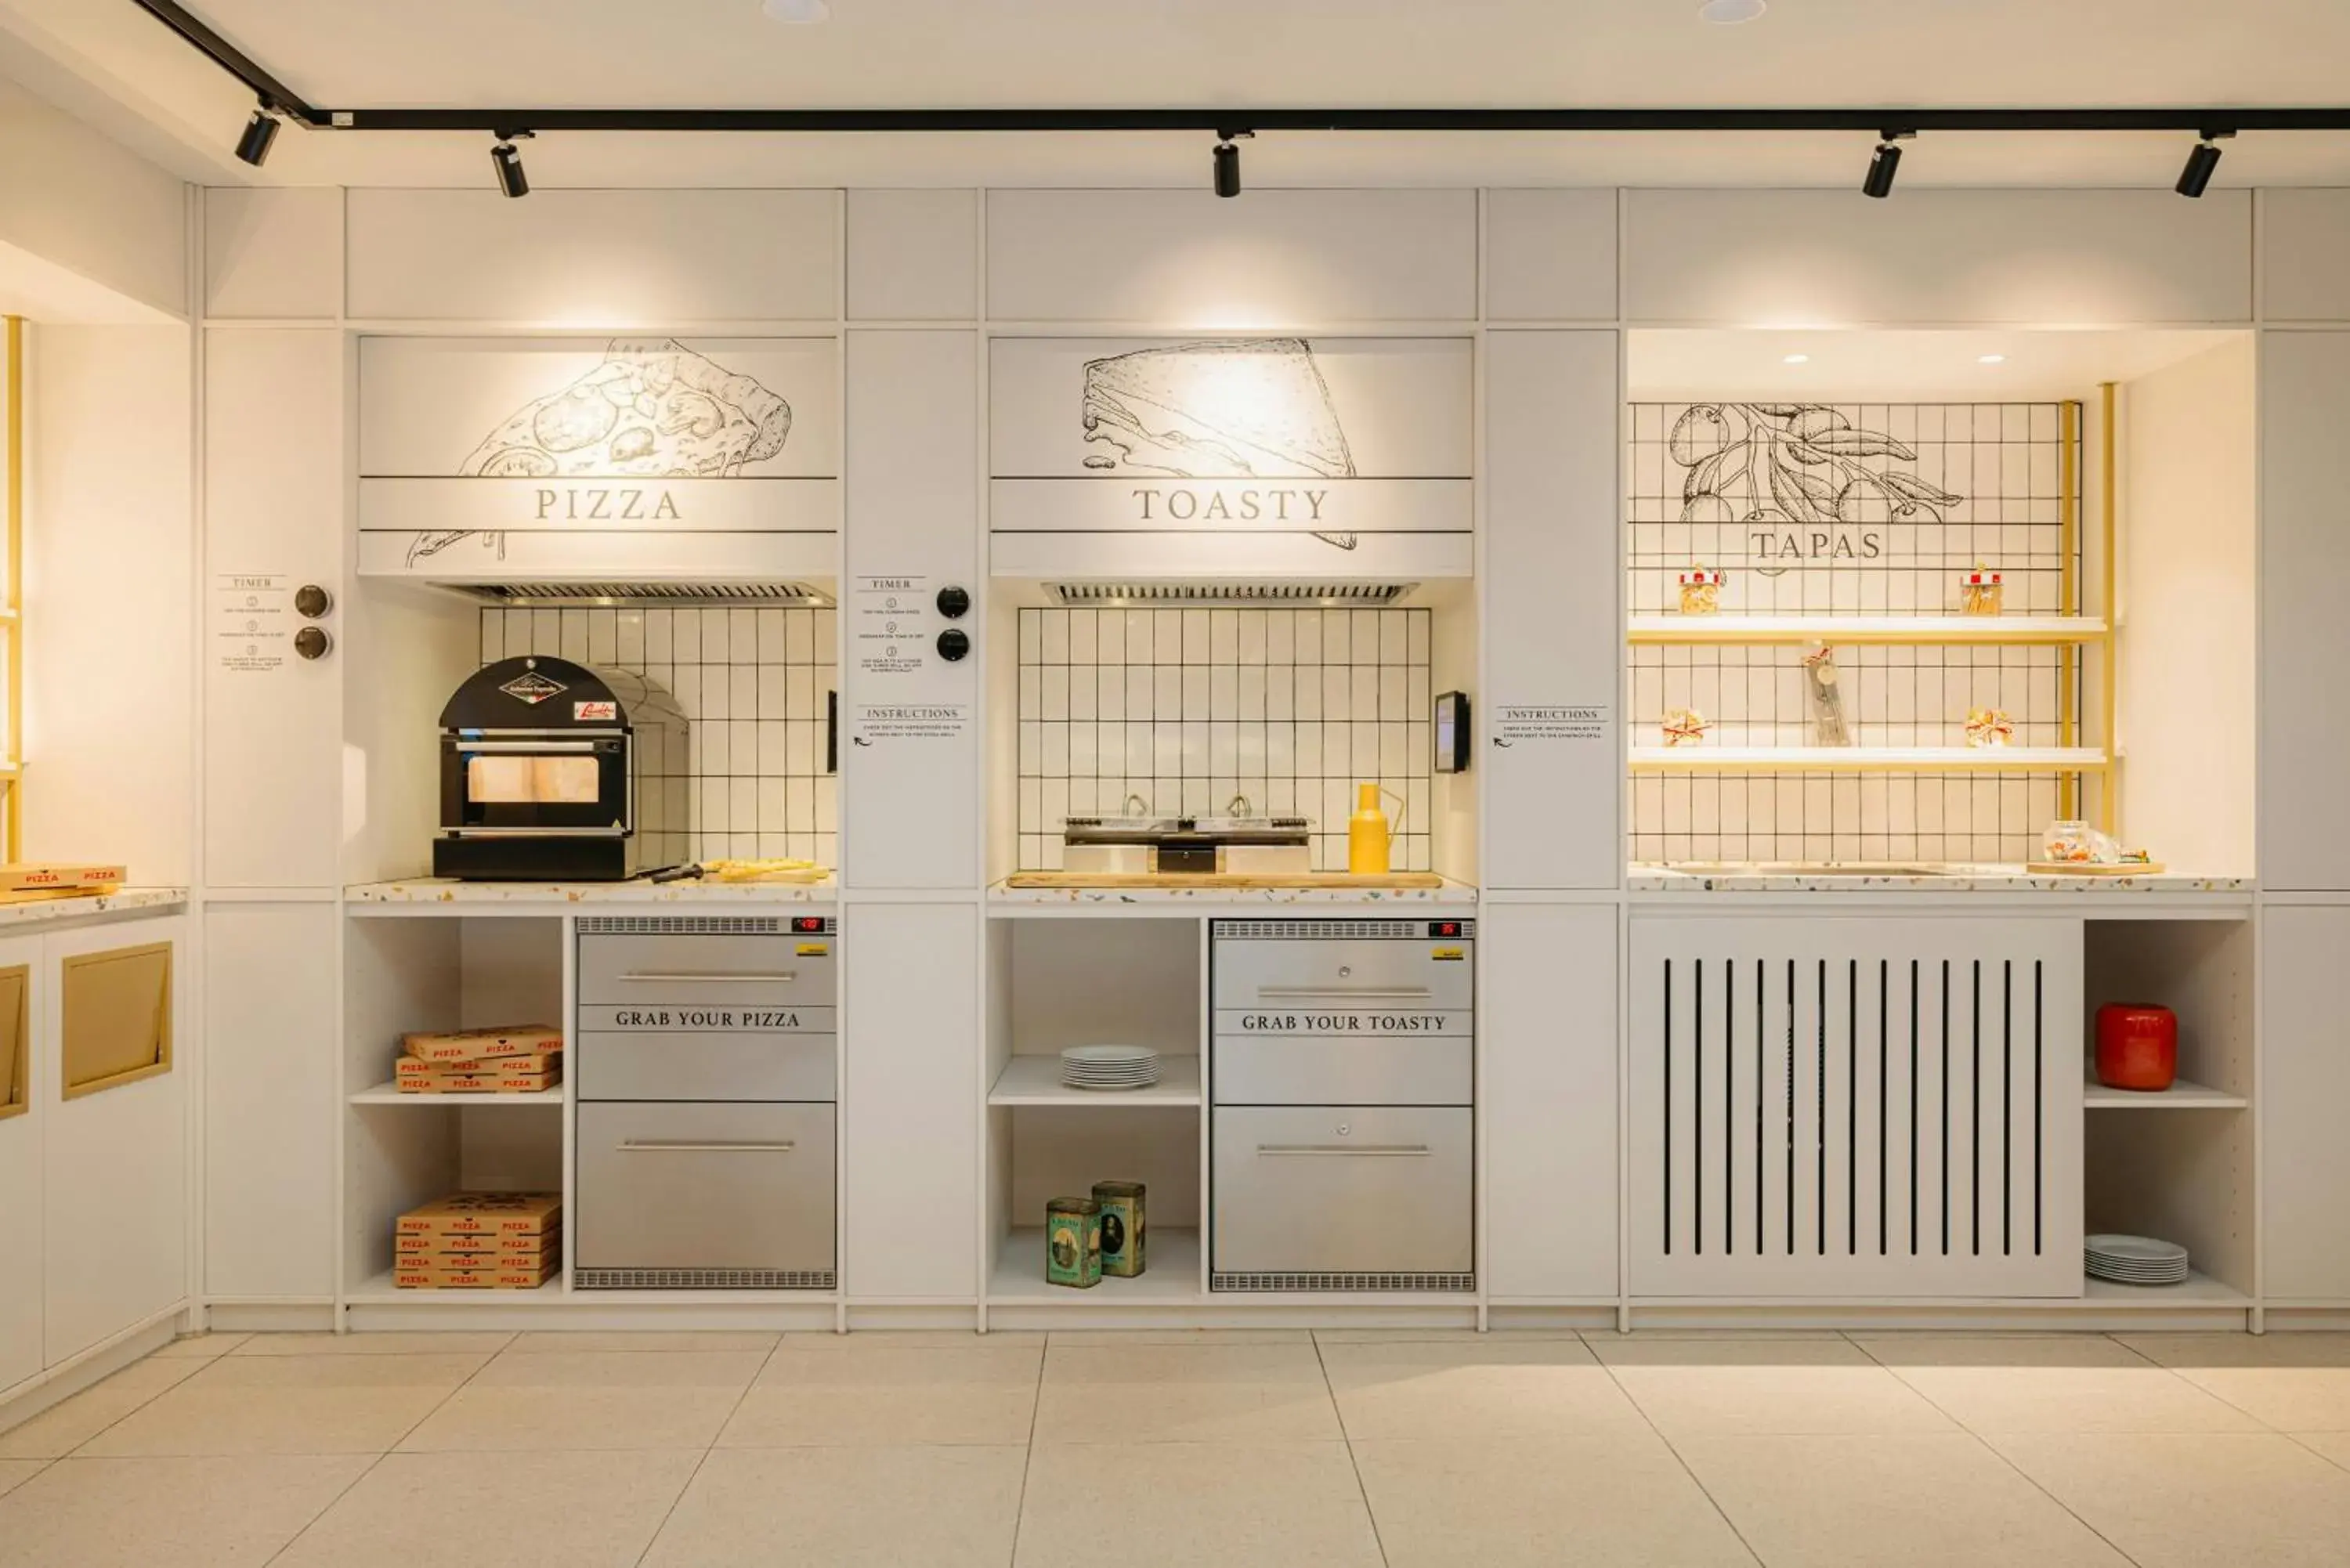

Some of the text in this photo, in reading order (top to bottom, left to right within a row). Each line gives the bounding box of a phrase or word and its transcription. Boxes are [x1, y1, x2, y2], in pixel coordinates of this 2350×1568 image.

[535, 489, 682, 519] PIZZA
[1132, 490, 1328, 519] TOASTY
[1752, 533, 1879, 558] TAPAS
[233, 579, 271, 587] TIMER
[872, 580, 910, 588] TIMER
[867, 709, 959, 718] INSTRUCTIONS
[1507, 710, 1598, 719] INSTRUCTIONS
[26, 874, 59, 883] PIZZA
[616, 1012, 800, 1027] GRAB YOUR PIZZA
[1242, 1015, 1446, 1030] GRAB YOUR TOASTY
[433, 1050, 464, 1058] PIZZA
